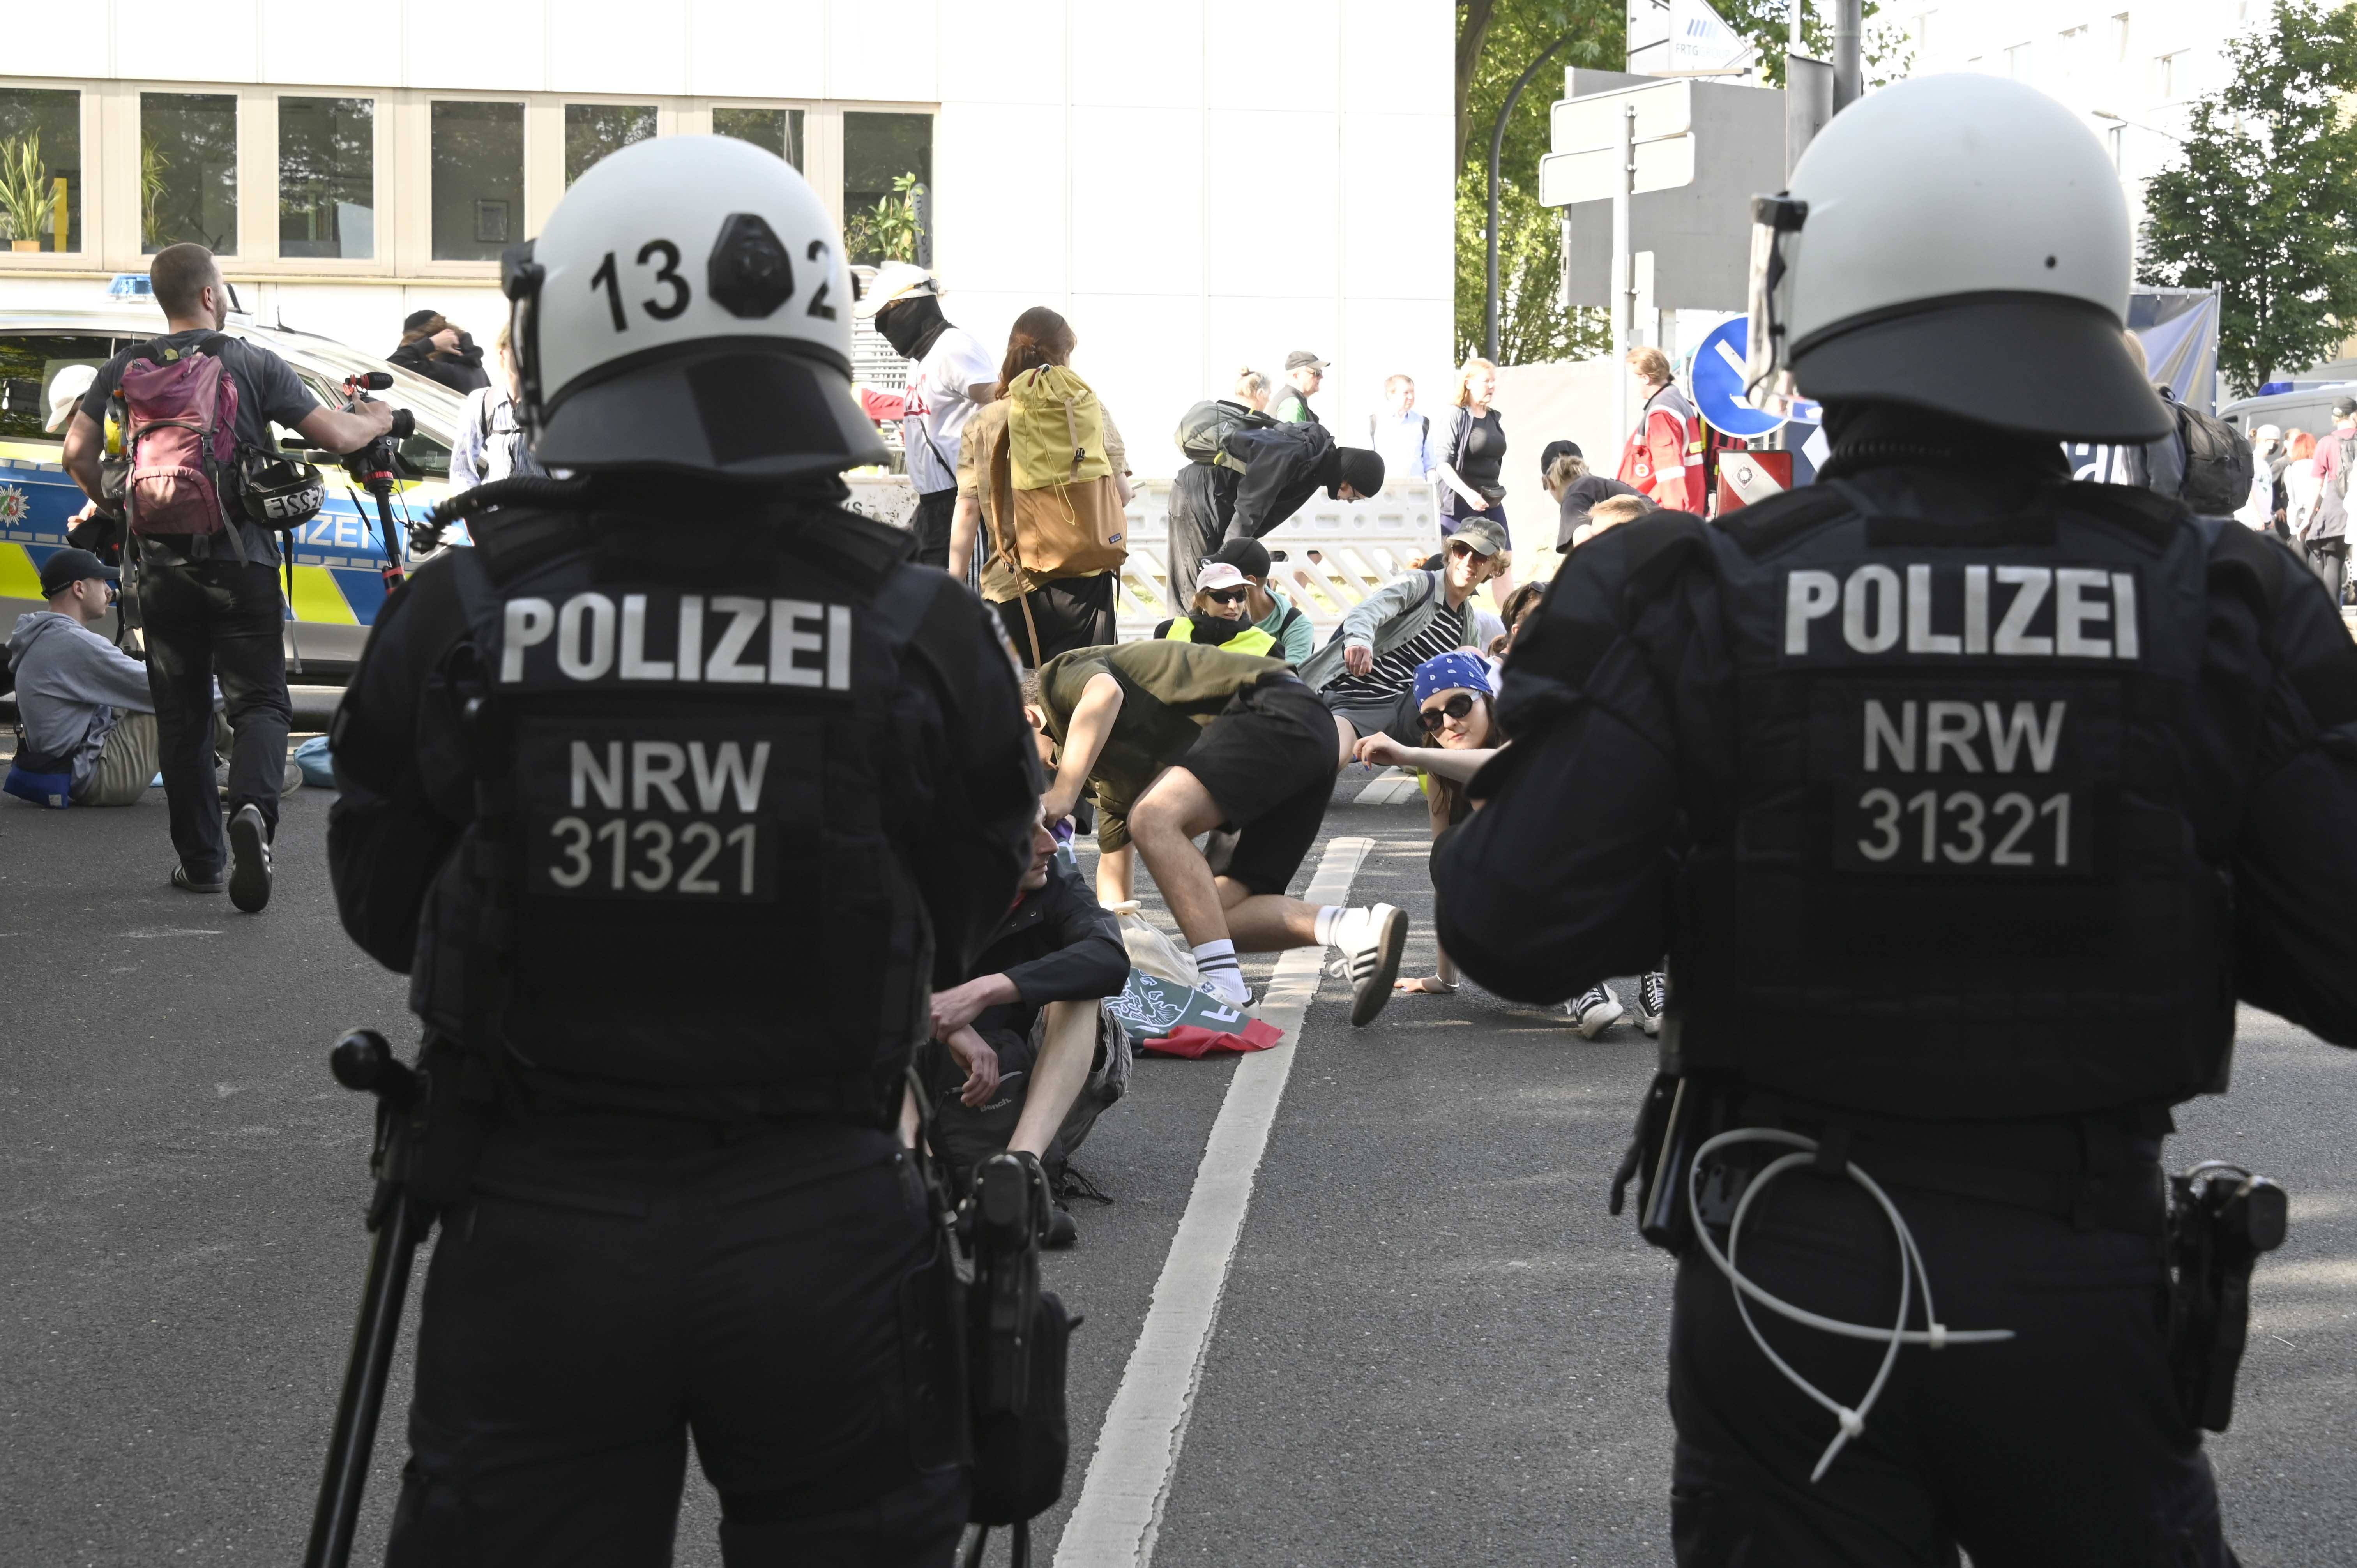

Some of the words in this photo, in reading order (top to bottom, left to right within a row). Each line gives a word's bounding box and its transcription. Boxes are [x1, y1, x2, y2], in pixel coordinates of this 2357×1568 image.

[591, 239, 692, 334] 13
[500, 592, 851, 690] POLIZEI
[1785, 564, 2139, 659] POLIZEI
[1863, 700, 2066, 773] NRW
[570, 741, 771, 812] NRW
[549, 817, 756, 895] 31321
[1857, 788, 2071, 866] 31321
